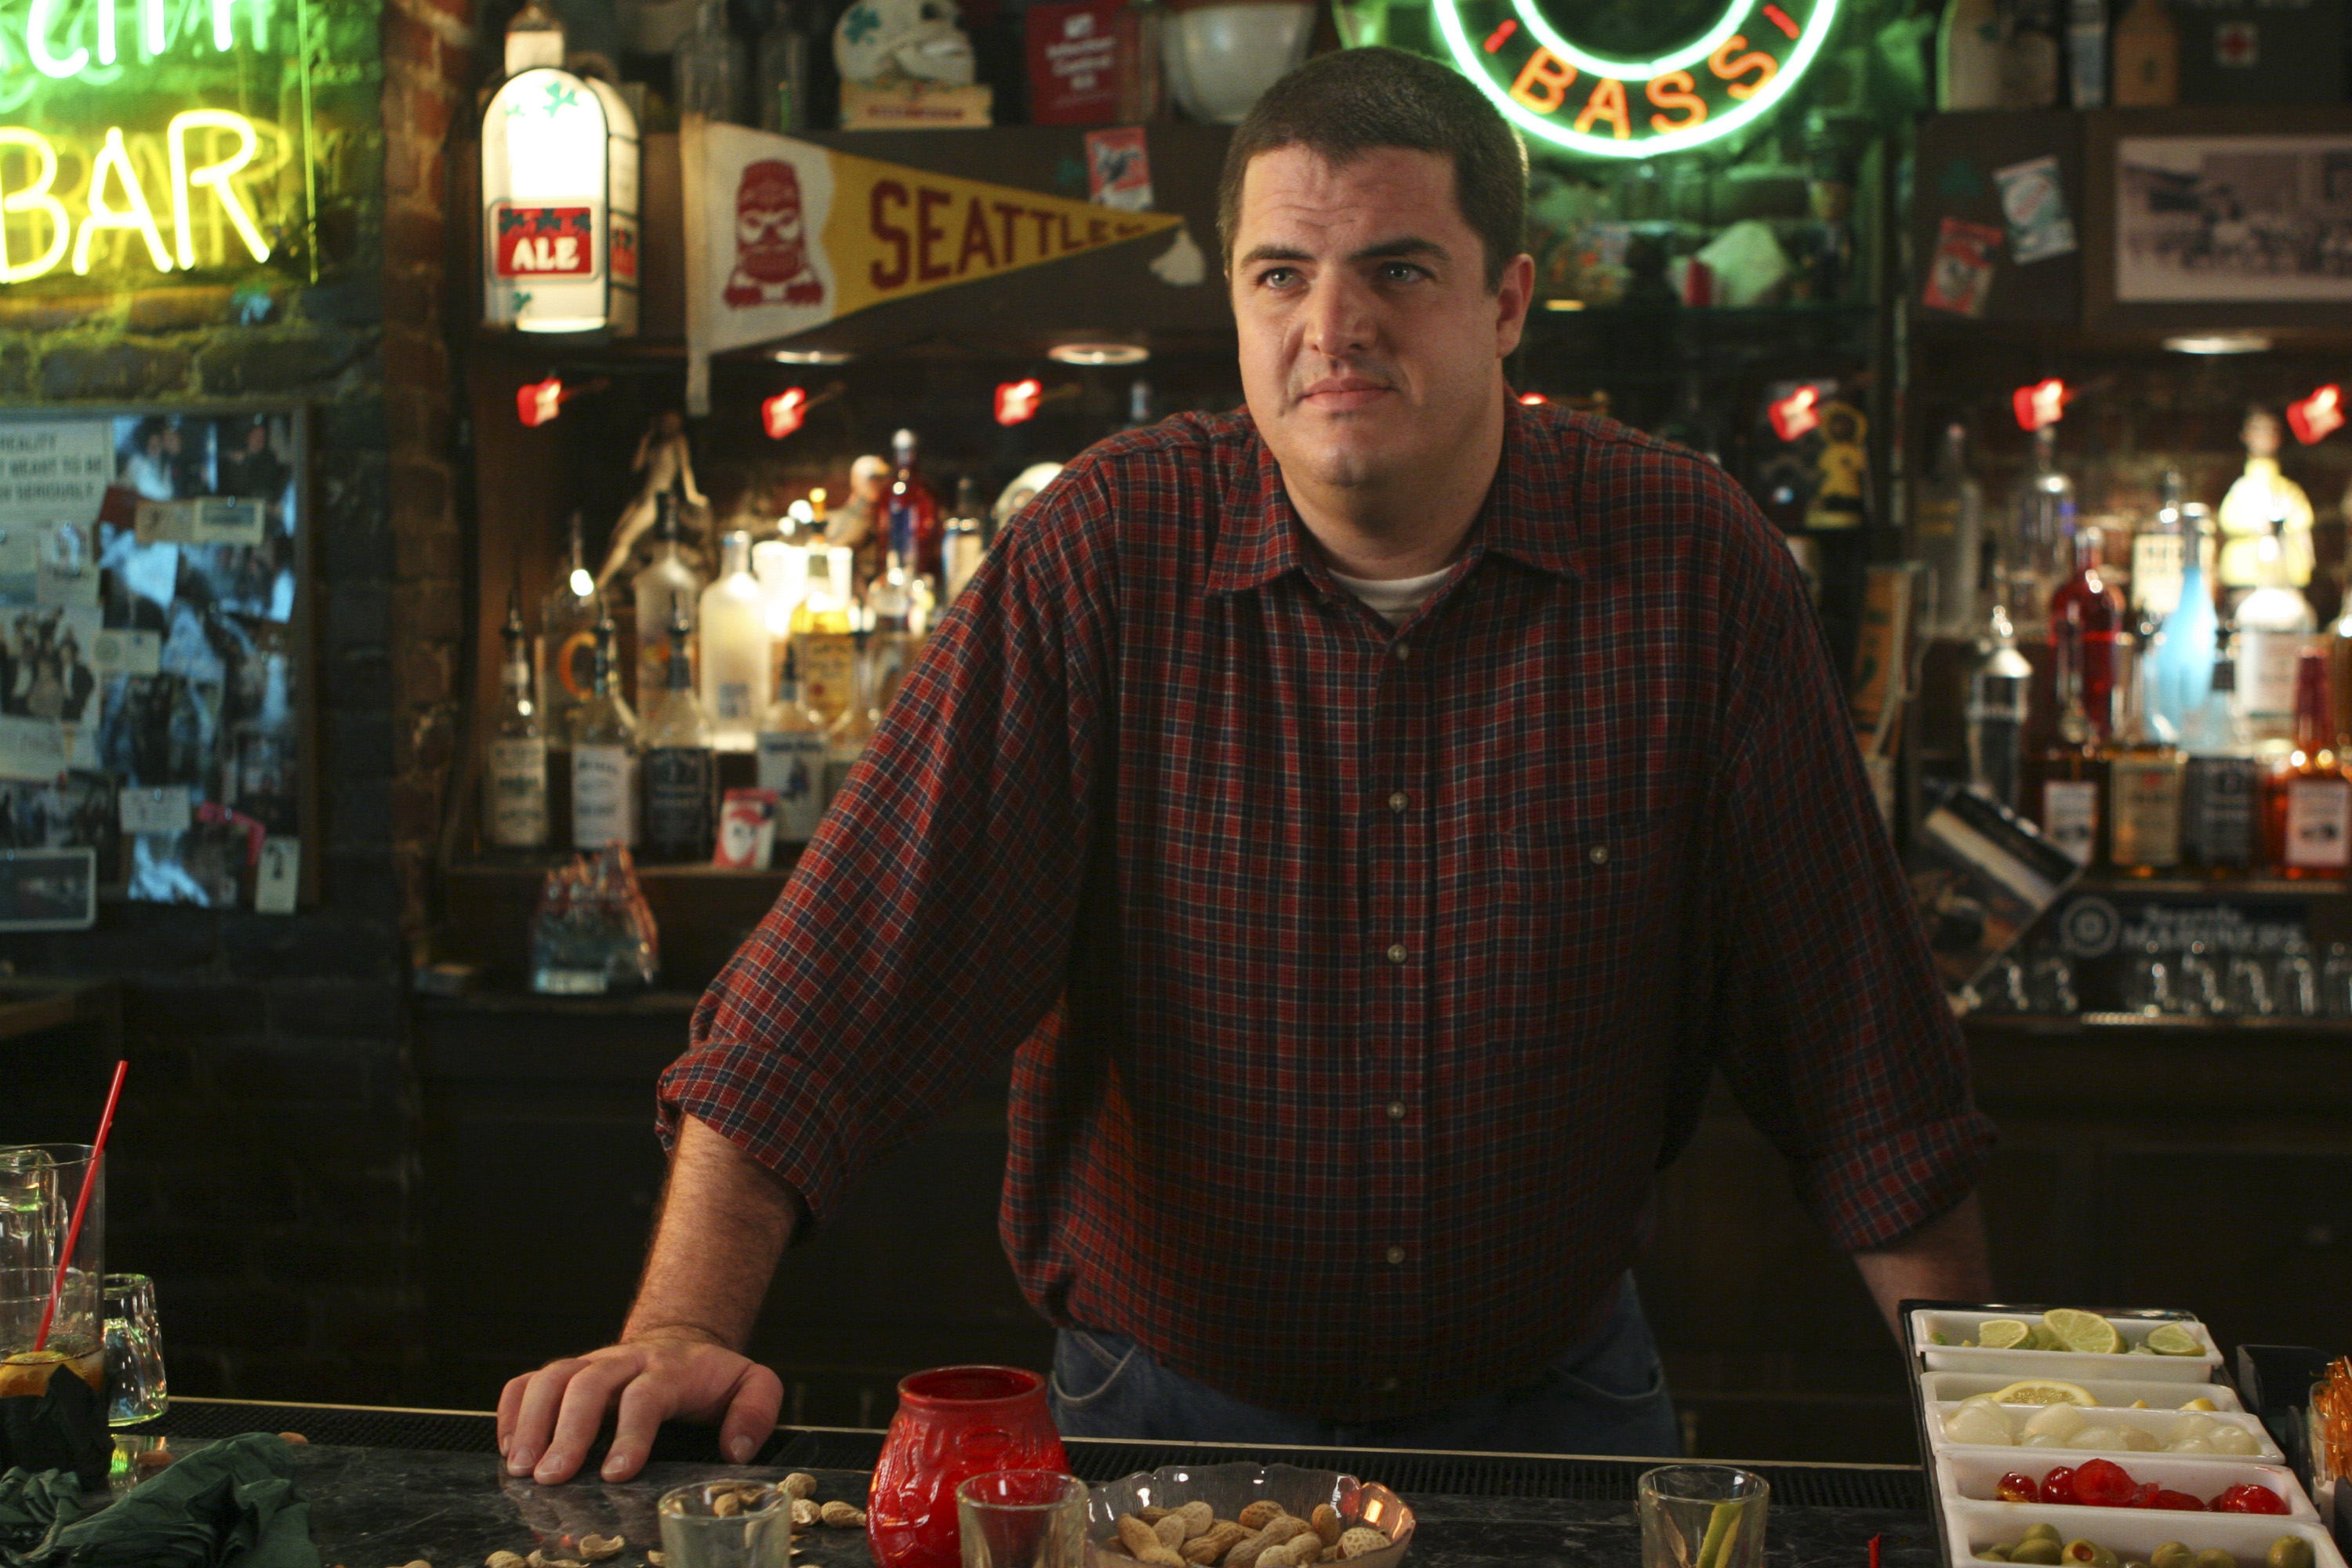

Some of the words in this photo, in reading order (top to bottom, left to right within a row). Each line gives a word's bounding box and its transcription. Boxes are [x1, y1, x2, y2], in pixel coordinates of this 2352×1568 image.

[1509, 34, 1779, 142] BASS
[0, 108, 271, 284] BAR
[869, 179, 1108, 290] SEATTLE
[511, 236, 580, 271] ALE
